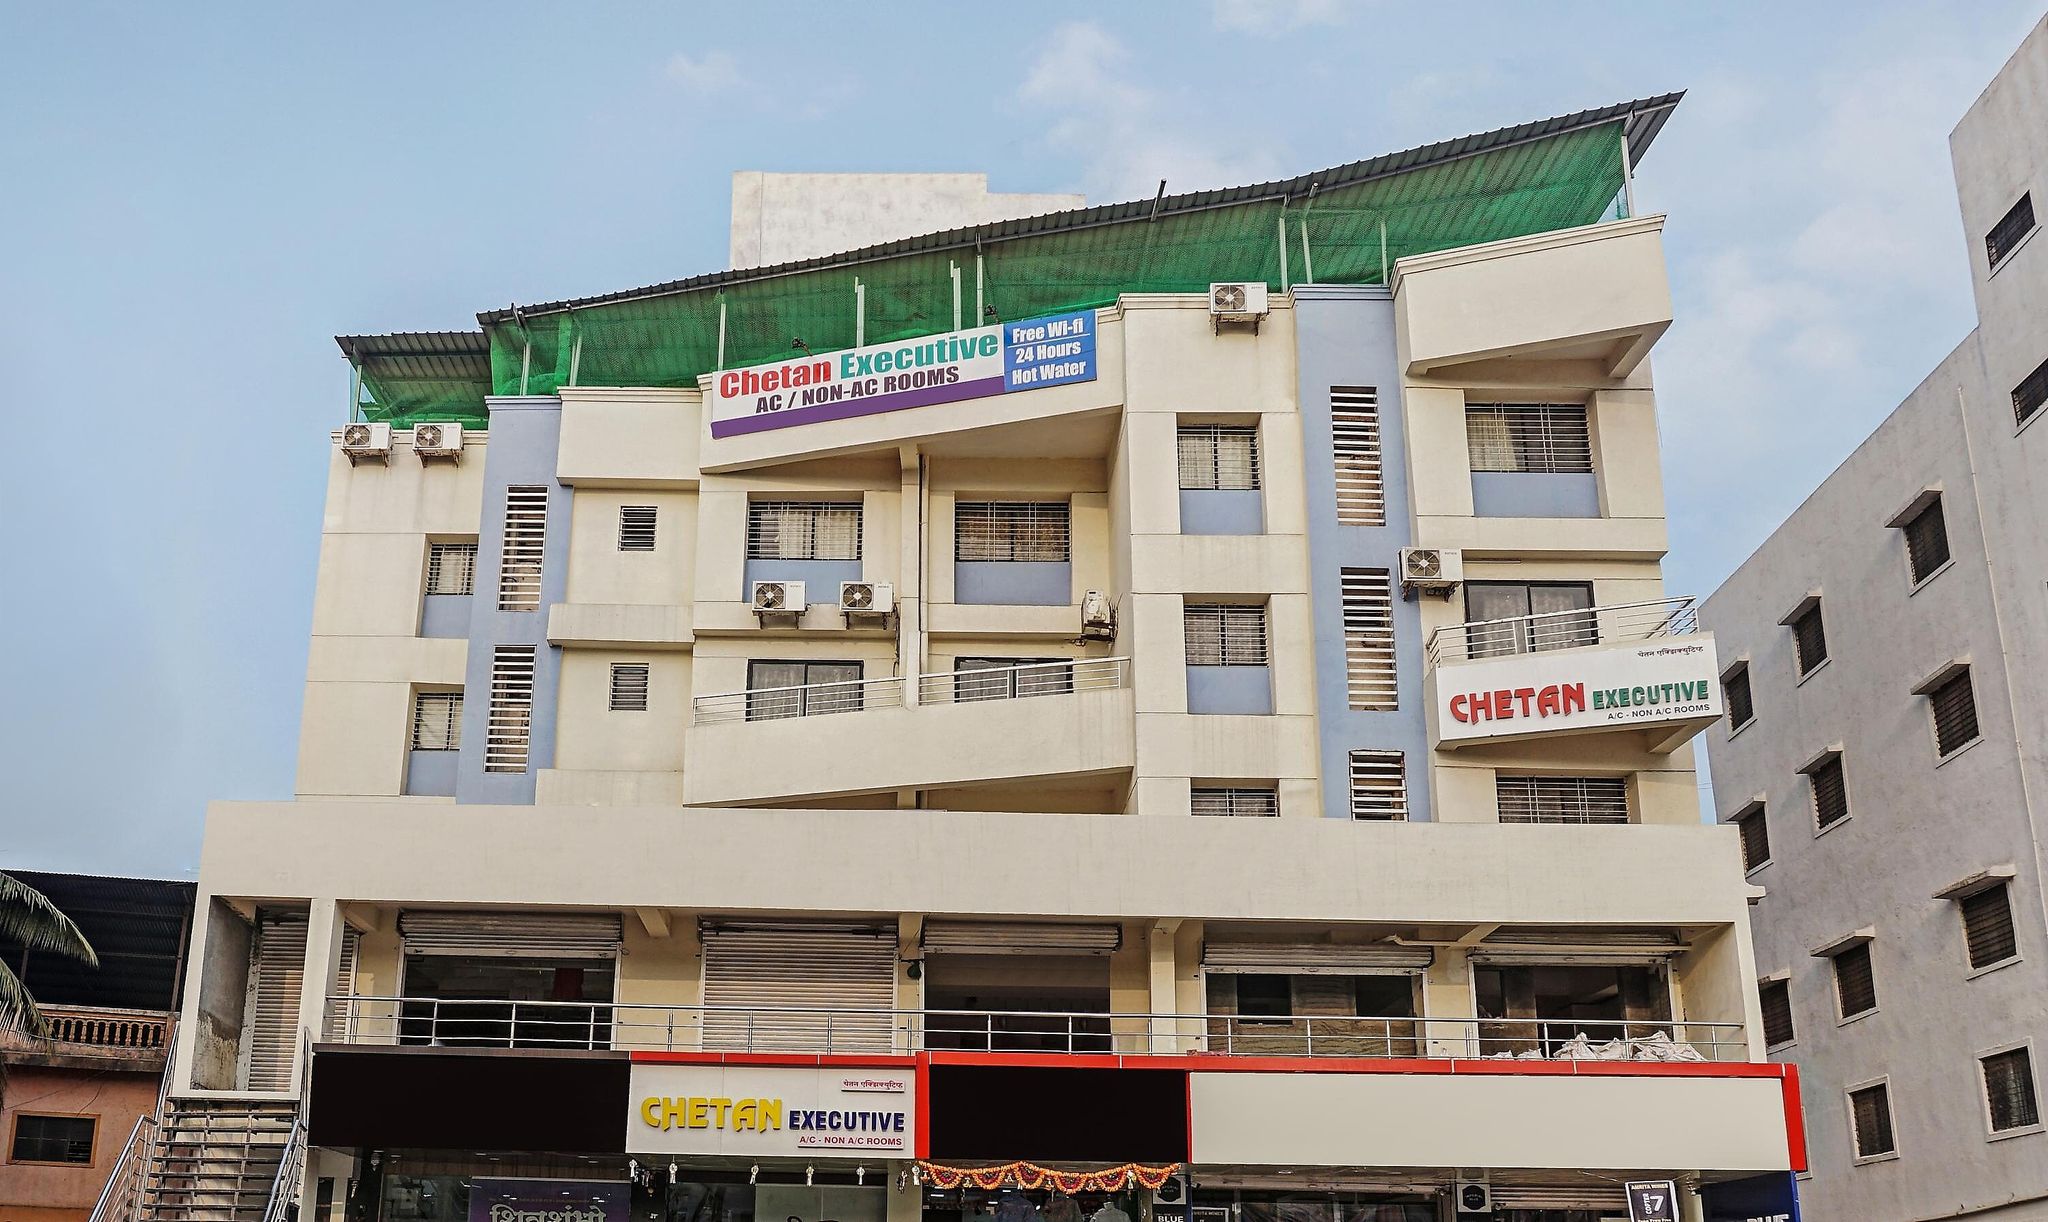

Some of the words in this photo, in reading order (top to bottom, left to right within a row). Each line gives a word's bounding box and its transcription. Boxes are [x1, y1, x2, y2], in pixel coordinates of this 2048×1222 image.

[1012, 326, 1045, 344] Free
[1047, 317, 1084, 338] Wi-fi
[1015, 346, 1034, 364] 24
[1036, 341, 1081, 361] Hours
[719, 360, 832, 399] Chetan
[839, 333, 999, 379] Executive
[1012, 367, 1037, 385] Hot
[1040, 361, 1086, 380] Water
[755, 395, 782, 414] AC
[801, 378, 878, 406] NON-AC
[883, 365, 959, 393] ROOMS
[1449, 682, 1586, 726] CHETAN
[1592, 680, 1709, 710] EXECUTIVE
[1607, 711, 1624, 720] A/C
[1632, 709, 1653, 718] NON
[1655, 707, 1673, 716] A/C
[1674, 703, 1711, 714] ROOMS
[641, 1096, 782, 1133] CHETAN
[789, 1110, 905, 1132] EXECUTIVE
[799, 1136, 817, 1144] A/C
[824, 1136, 846, 1144] NON
[847, 1137, 865, 1145] A/C
[866, 1137, 903, 1146] ROOMS
[1649, 1195, 1664, 1212] 7
